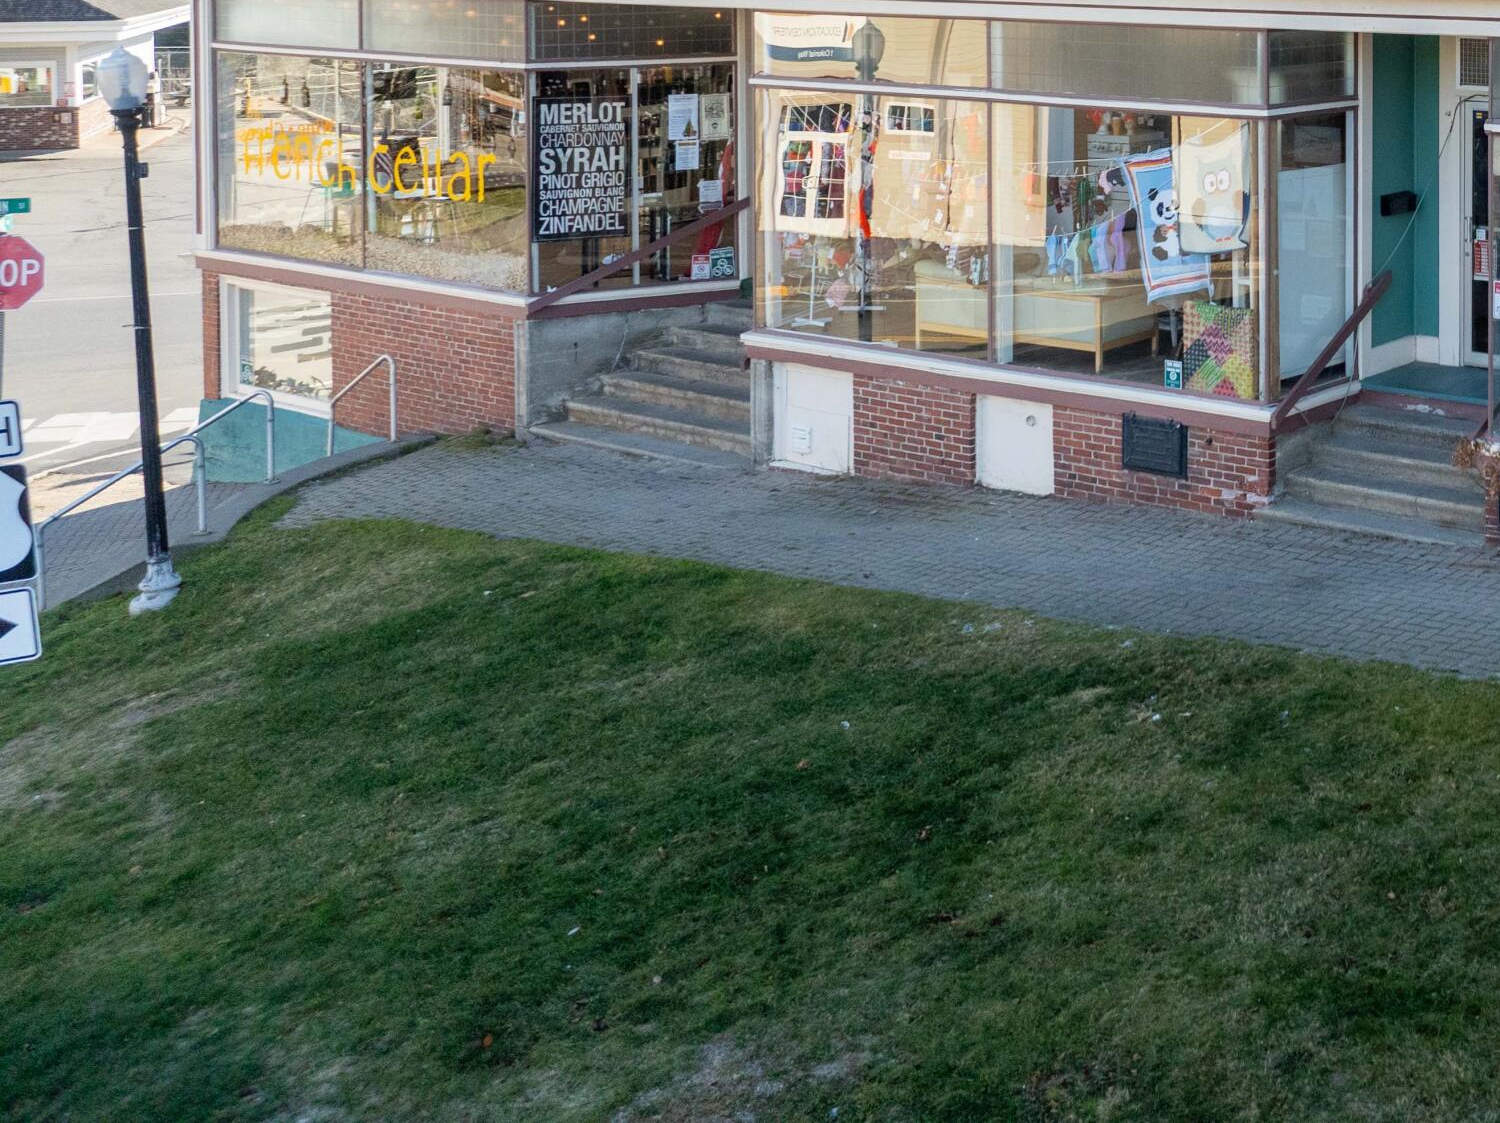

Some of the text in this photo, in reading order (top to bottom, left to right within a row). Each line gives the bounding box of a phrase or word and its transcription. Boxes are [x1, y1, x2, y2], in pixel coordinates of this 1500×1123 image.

[540, 102, 625, 125] MERLOT
[540, 123, 625, 134] CABERNET SAUVIGNON
[540, 132, 625, 148] CHARDONNAY
[540, 146, 625, 174] SYRAH
[540, 171, 625, 190] PINOT GRIGIO
[540, 186, 625, 200] SAUVIGNON BLANC
[540, 196, 625, 217] CHAMPAGNE
[539, 213, 625, 235] ZINFANDEL
